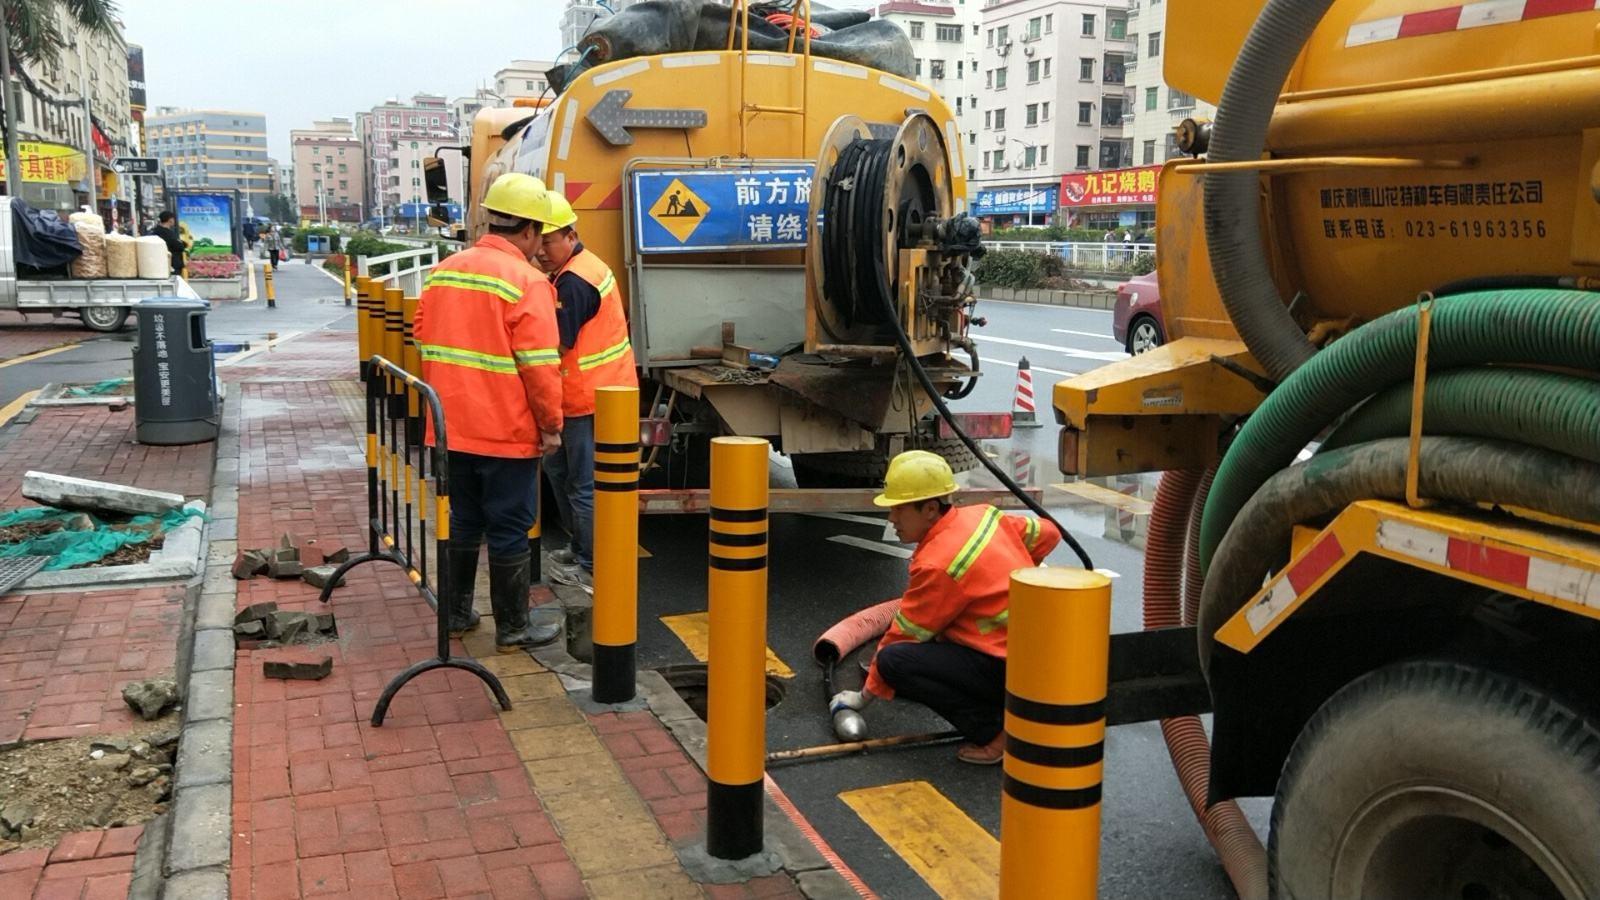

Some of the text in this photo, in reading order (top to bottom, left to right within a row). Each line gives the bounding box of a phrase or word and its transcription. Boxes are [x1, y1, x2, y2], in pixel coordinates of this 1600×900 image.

[735, 177, 813, 206] 前方施
[1086, 170, 1161, 194] 九记烧鹅
[1320, 180, 1543, 209] 重庆耐德山花特种车有限责任公司
[153, 314, 168, 359] 垃圾不落地
